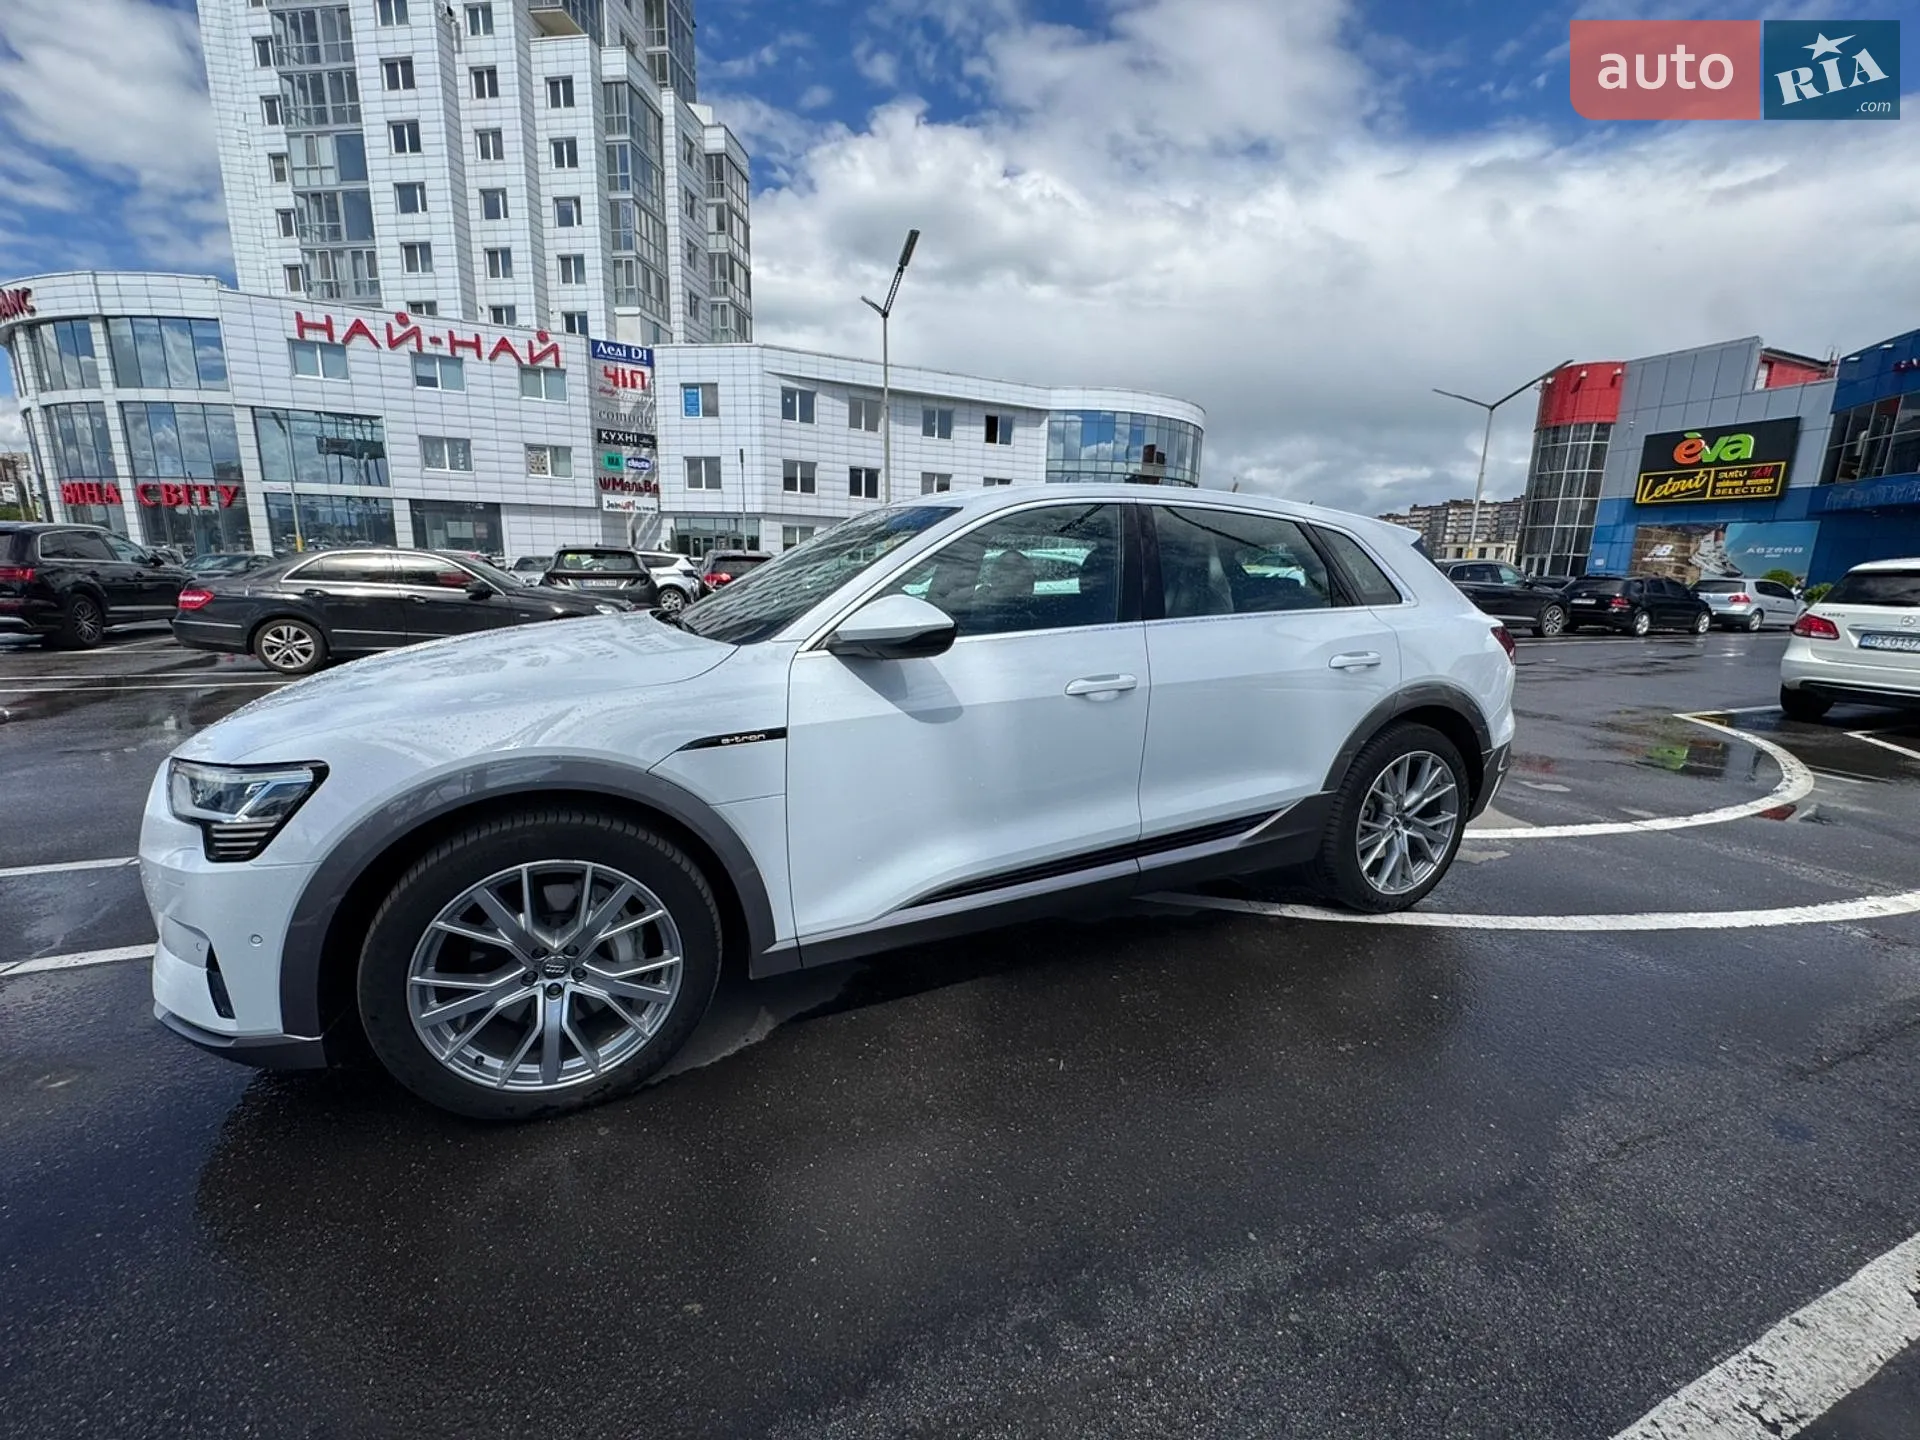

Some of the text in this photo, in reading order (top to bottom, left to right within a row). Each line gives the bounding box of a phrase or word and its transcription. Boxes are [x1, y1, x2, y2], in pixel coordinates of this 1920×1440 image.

[294, 310, 562, 368] НАЙ-НАЙ
[601, 430, 638, 443] КУХНІ
[136, 483, 240, 508] СВІТУ
[721, 733, 766, 745] e-tron
